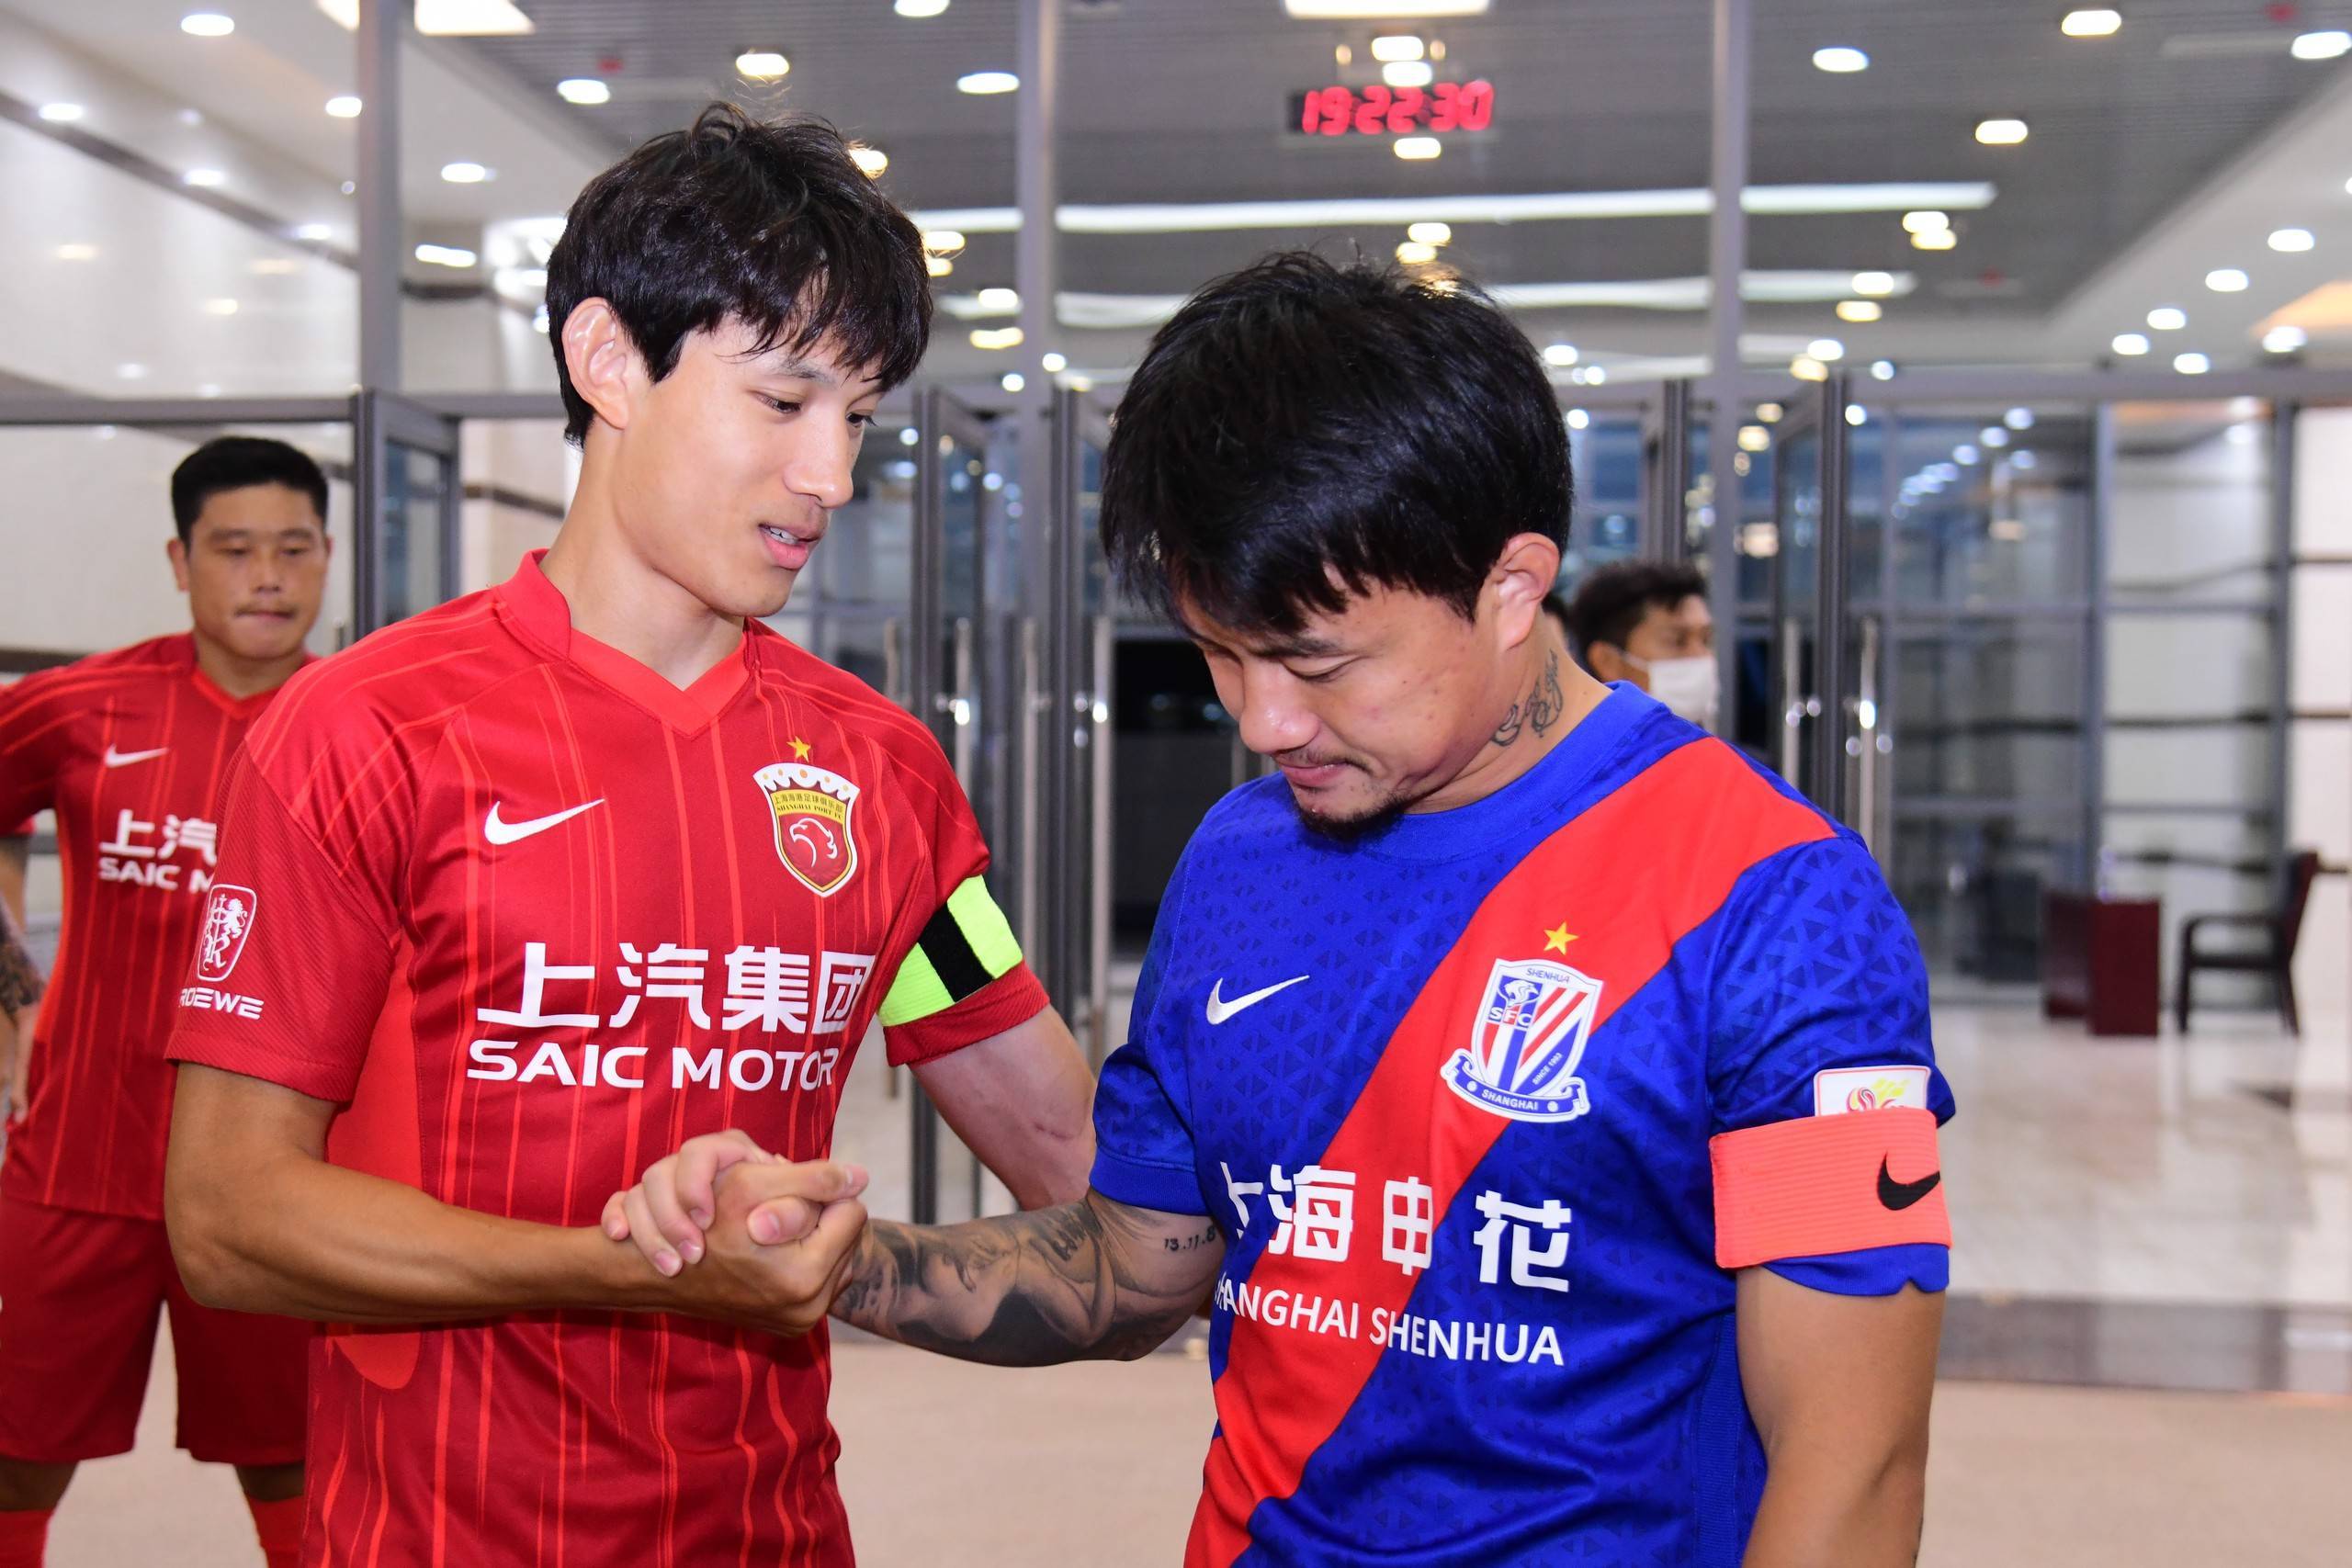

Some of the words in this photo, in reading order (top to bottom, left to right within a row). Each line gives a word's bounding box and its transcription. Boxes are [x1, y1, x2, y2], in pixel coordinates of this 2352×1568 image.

[98, 856, 181, 891] SAIC
[476, 942, 876, 1035] 上汽集团
[1525, 967, 1570, 984] SHENHUA
[1487, 1006, 1532, 1029] SFC
[467, 1039, 650, 1089] SAIC
[672, 1046, 840, 1091] MOTOR
[1481, 1089, 1540, 1111] SHANGHAI
[1369, 1306, 1565, 1367] SHENHUA
